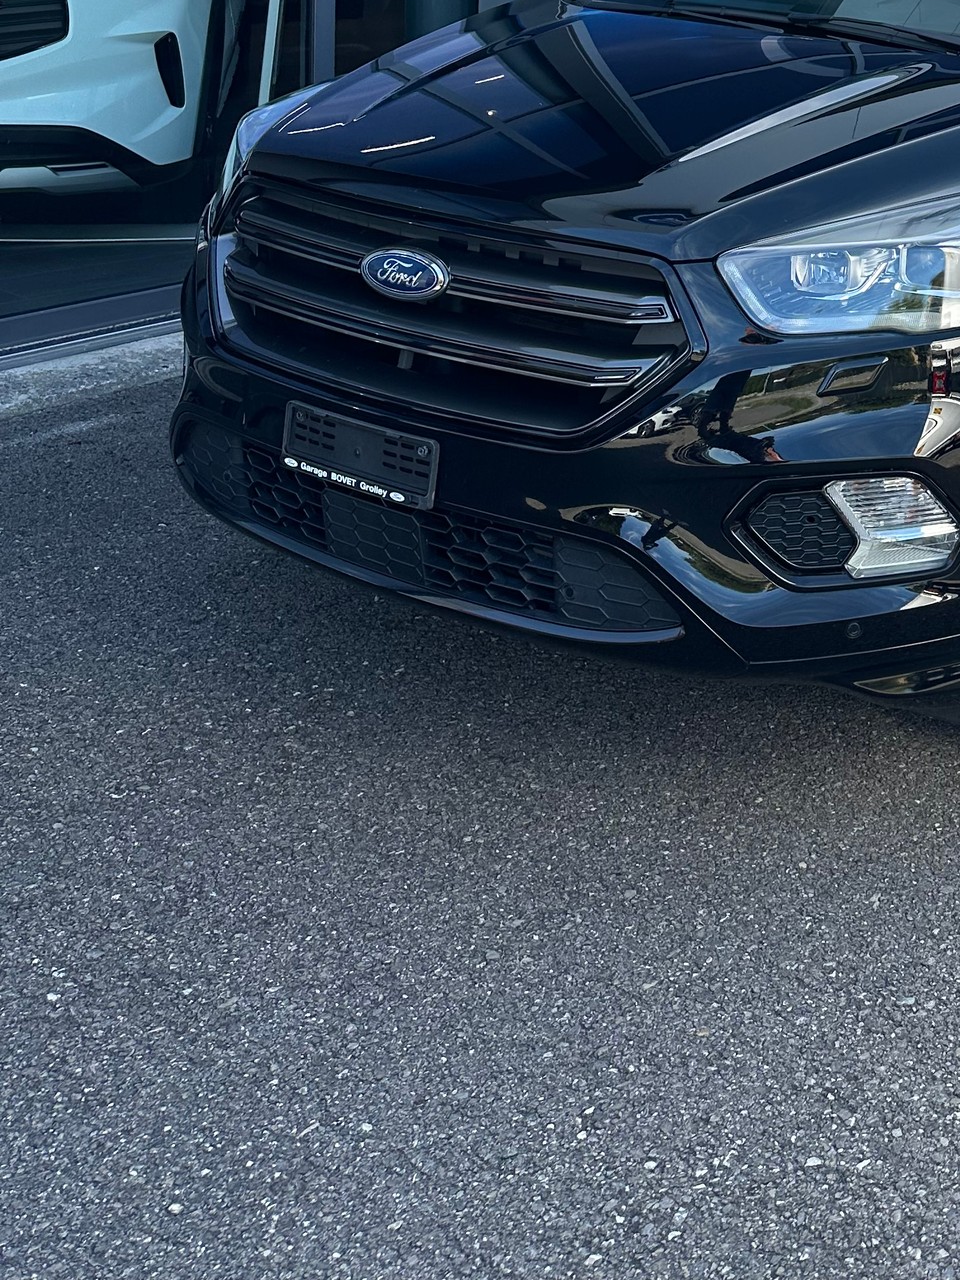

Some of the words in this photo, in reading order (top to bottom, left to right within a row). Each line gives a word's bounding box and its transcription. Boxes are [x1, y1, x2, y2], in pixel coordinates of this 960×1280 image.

[377, 258, 422, 288] Ford
[300, 461, 328, 478] Garage
[330, 471, 357, 487] BOVET
[359, 481, 388, 498] Grolley
